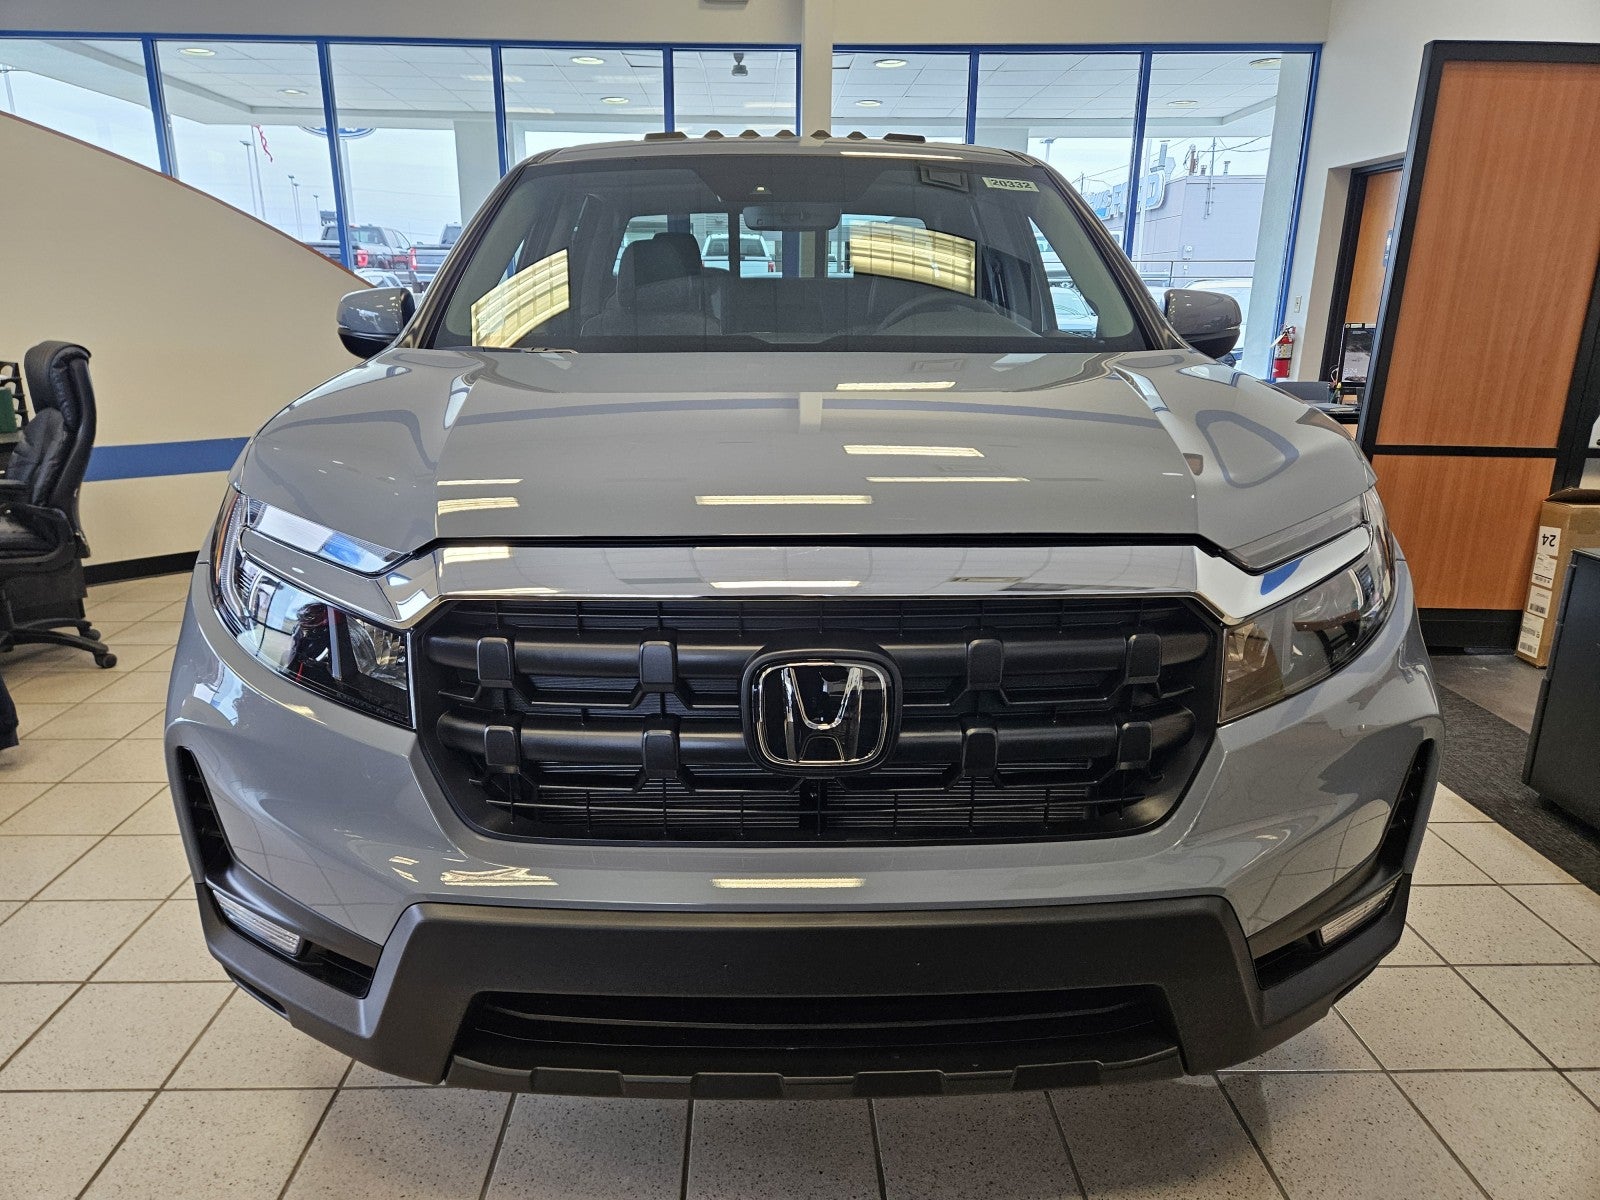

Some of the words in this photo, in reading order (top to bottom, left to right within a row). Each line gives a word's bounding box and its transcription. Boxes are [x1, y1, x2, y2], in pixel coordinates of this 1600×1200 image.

[991, 179, 1032, 189] 20332
[1112, 171, 1165, 216] FD
[1541, 533, 1557, 547] 24
